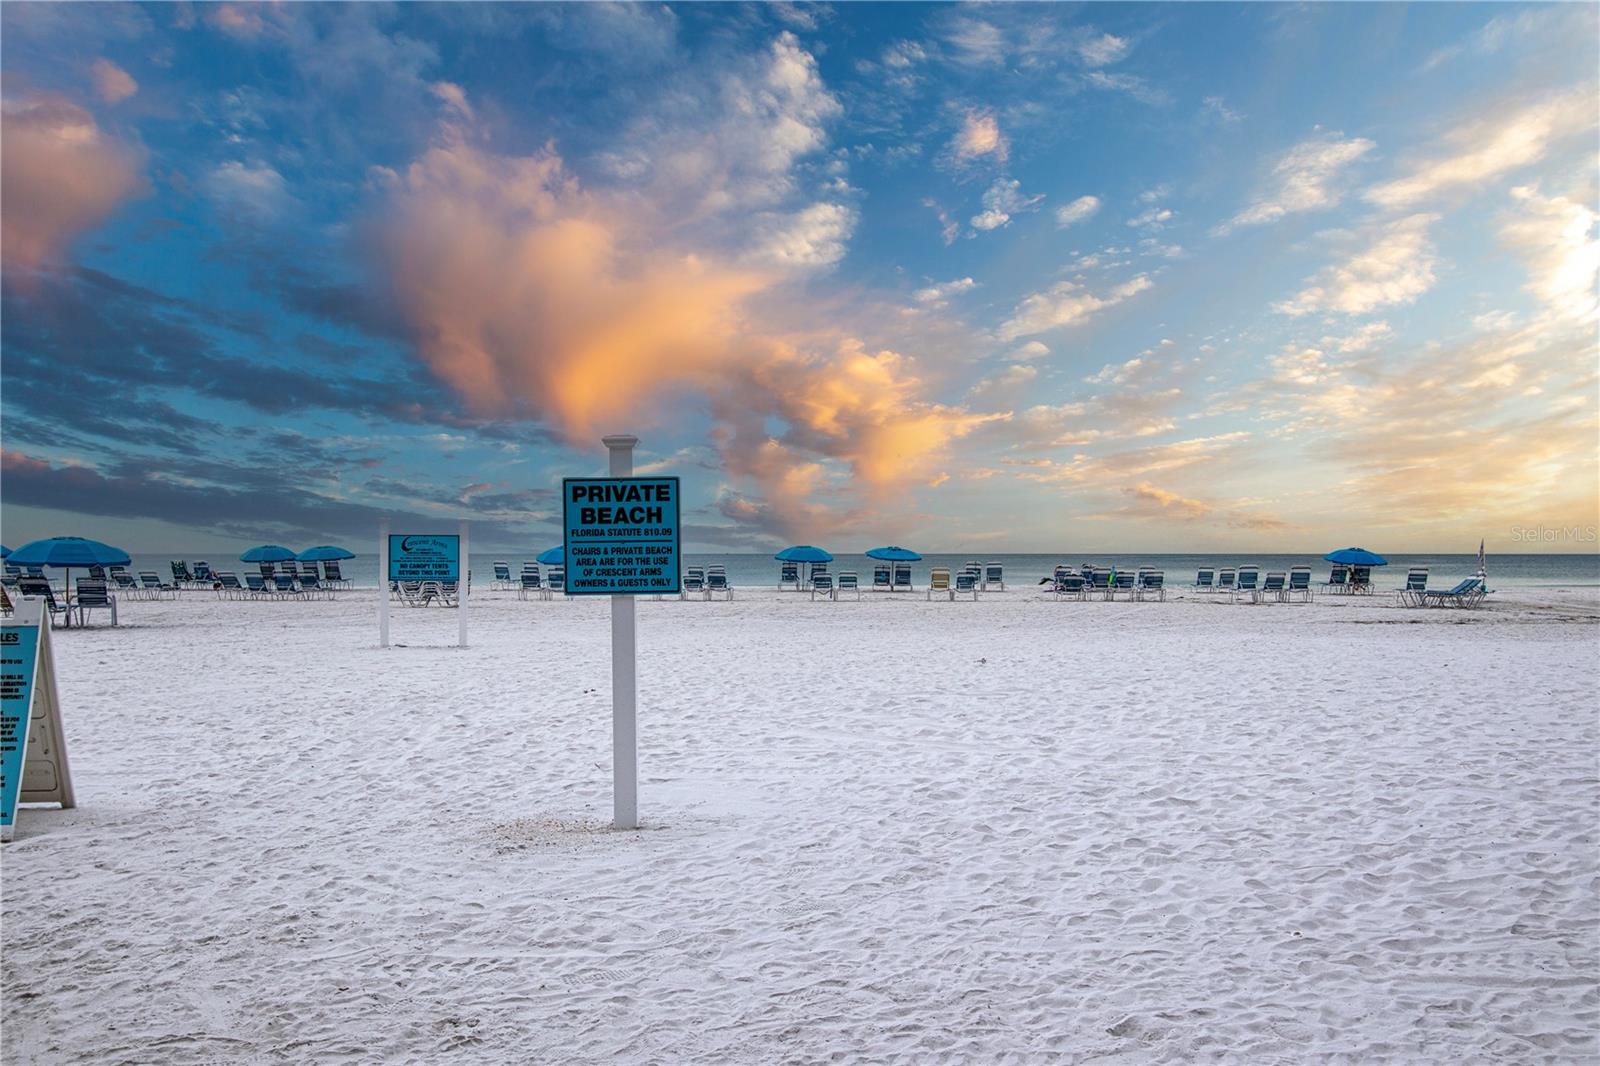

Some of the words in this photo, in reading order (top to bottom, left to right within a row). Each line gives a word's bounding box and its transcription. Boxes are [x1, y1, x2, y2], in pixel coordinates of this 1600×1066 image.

[572, 485, 671, 503] PRIVATE
[580, 506, 663, 525] BEACH
[571, 528, 605, 537] FLORIDA
[607, 528, 642, 537] STATUTE
[644, 528, 672, 536] 810.09
[572, 547, 601, 556] CHAIRS
[603, 547, 609, 555] &
[611, 547, 643, 555] PRIVATE
[645, 546, 673, 555] BEACH
[576, 558, 597, 566] AREA
[599, 558, 615, 566] ARE
[617, 557, 634, 566] FOR
[635, 557, 651, 565] THE
[653, 557, 669, 565] USE
[583, 568, 593, 577] OF
[595, 568, 637, 577] CRESCENT
[639, 567, 662, 576] ARMS
[574, 579, 608, 588] OWNERS
[610, 579, 616, 587] &
[617, 578, 649, 587] GUESTS
[650, 578, 672, 587] ONLY
